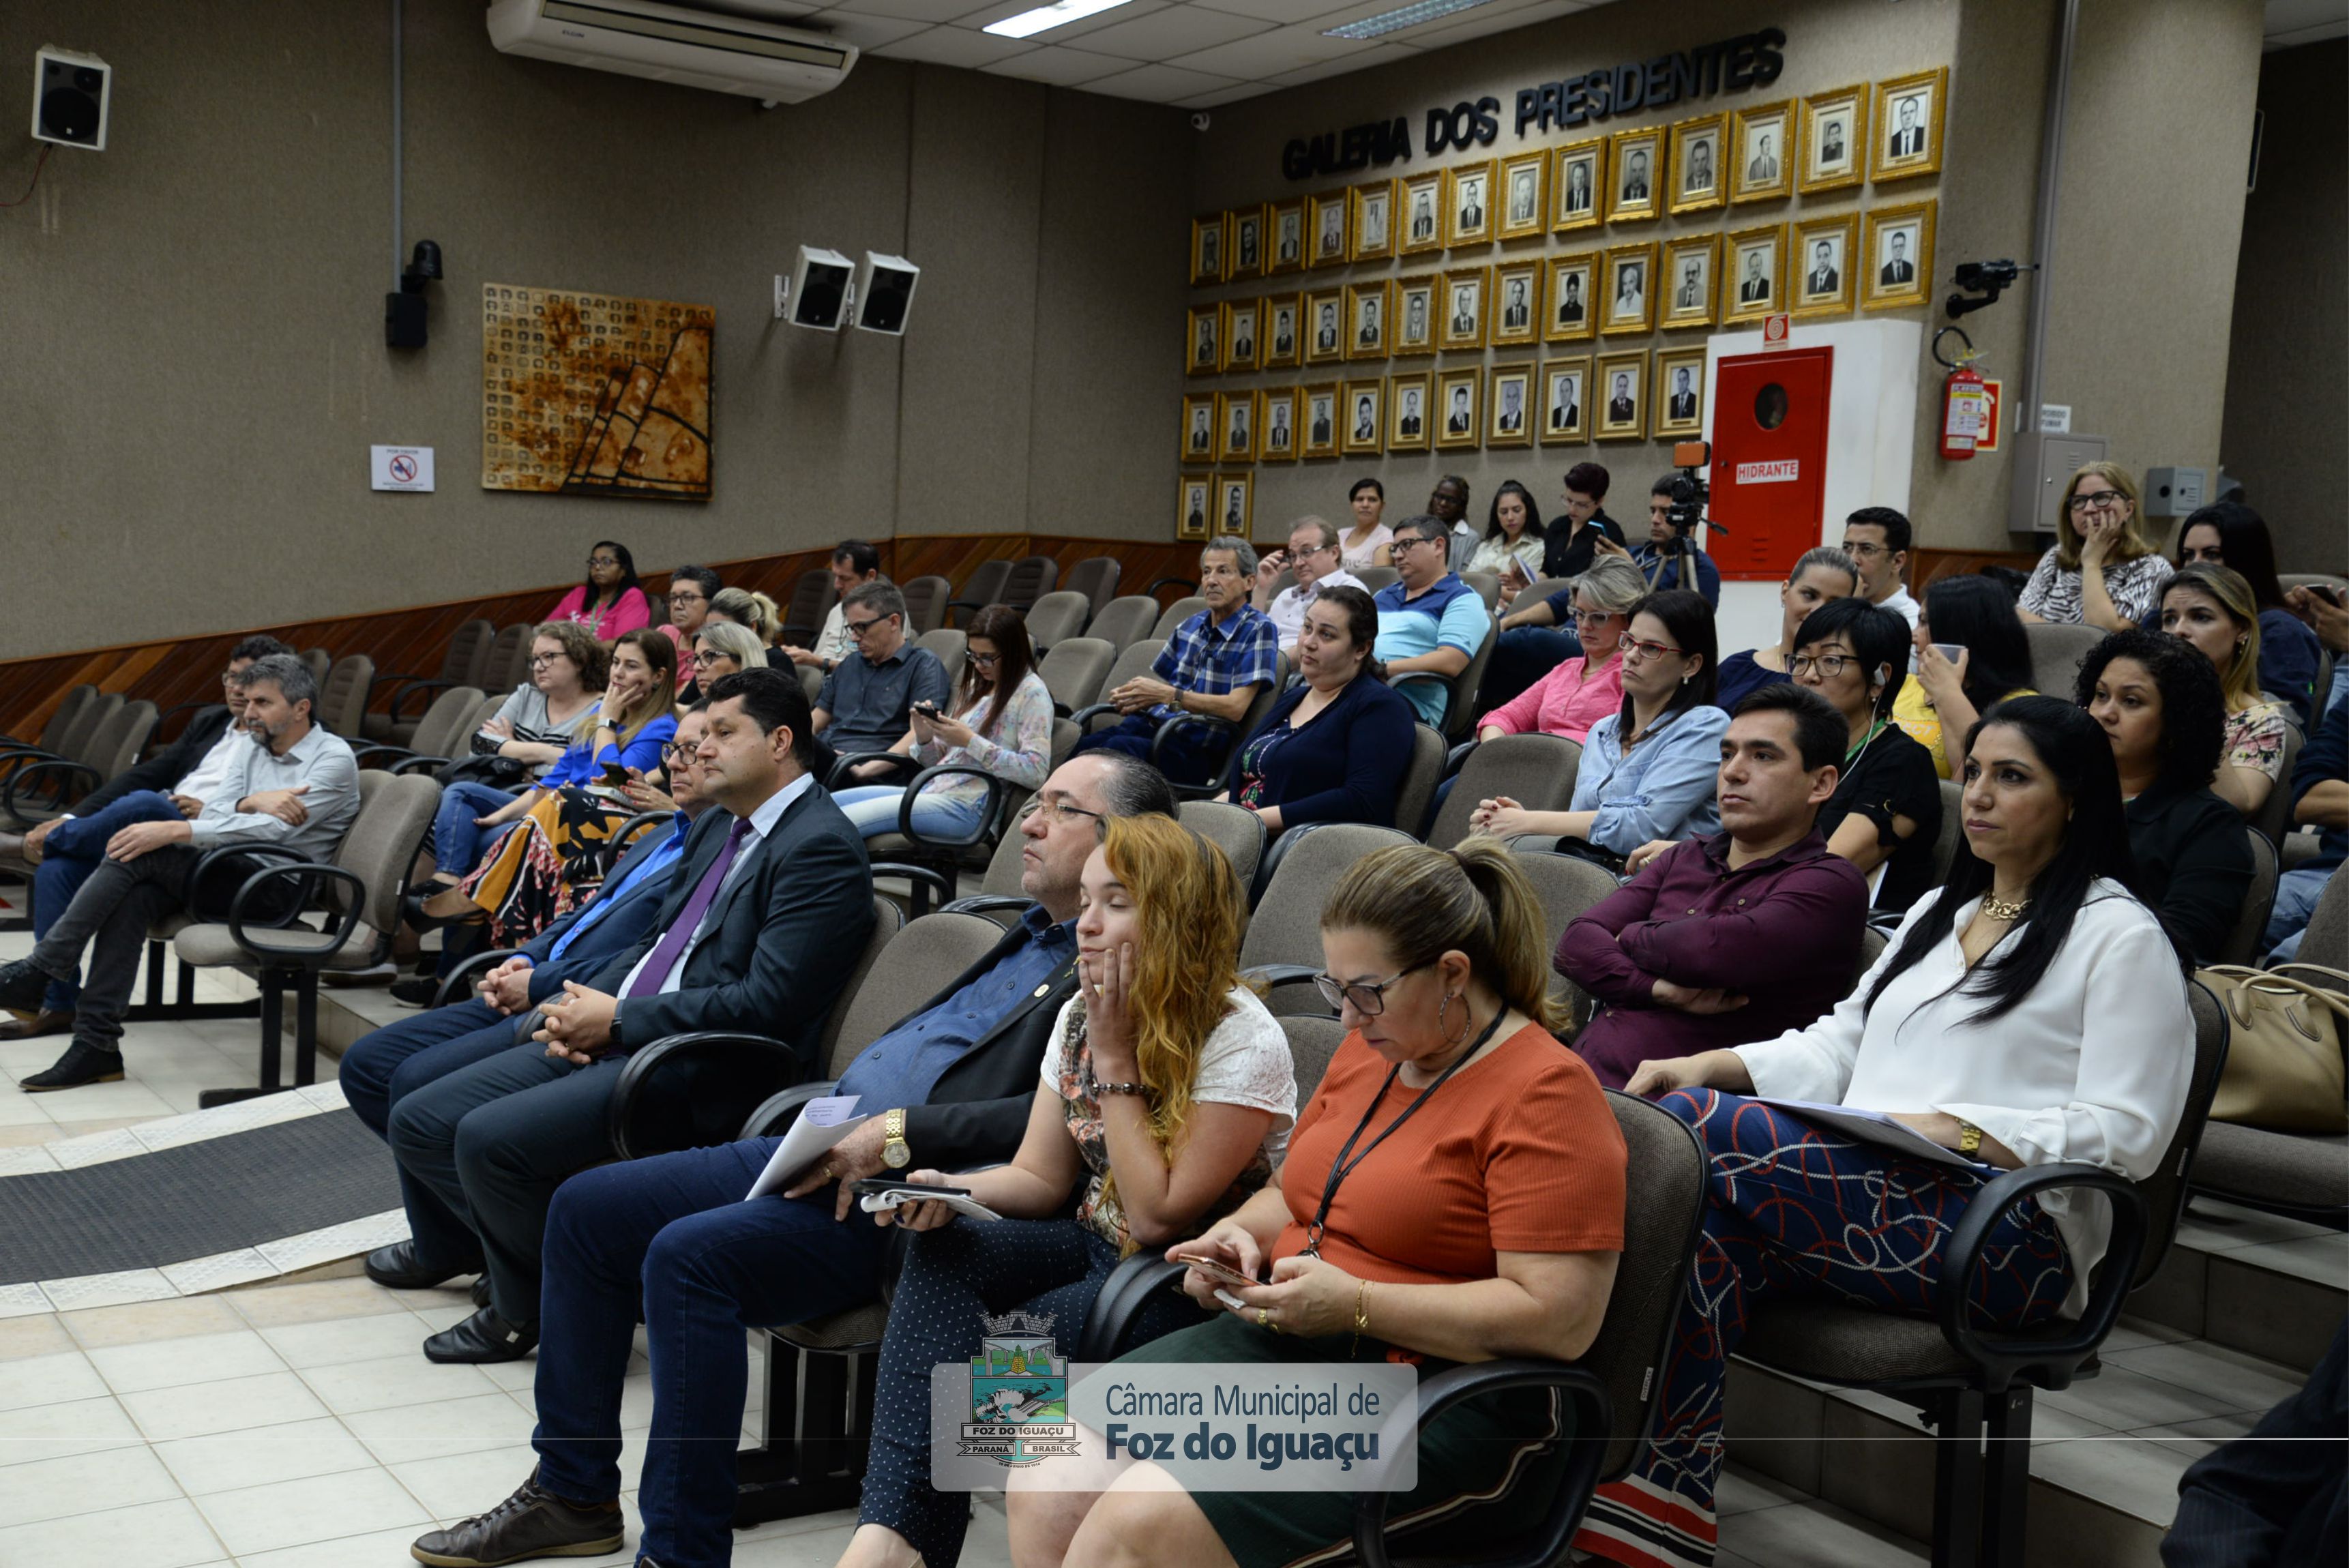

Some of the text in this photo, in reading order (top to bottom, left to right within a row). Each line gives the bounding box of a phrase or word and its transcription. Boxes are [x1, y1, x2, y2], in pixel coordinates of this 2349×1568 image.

[1282, 27, 1786, 181] GALERIA DOS PRESIDENTES
[1738, 462, 1796, 479] HIDRANTE
